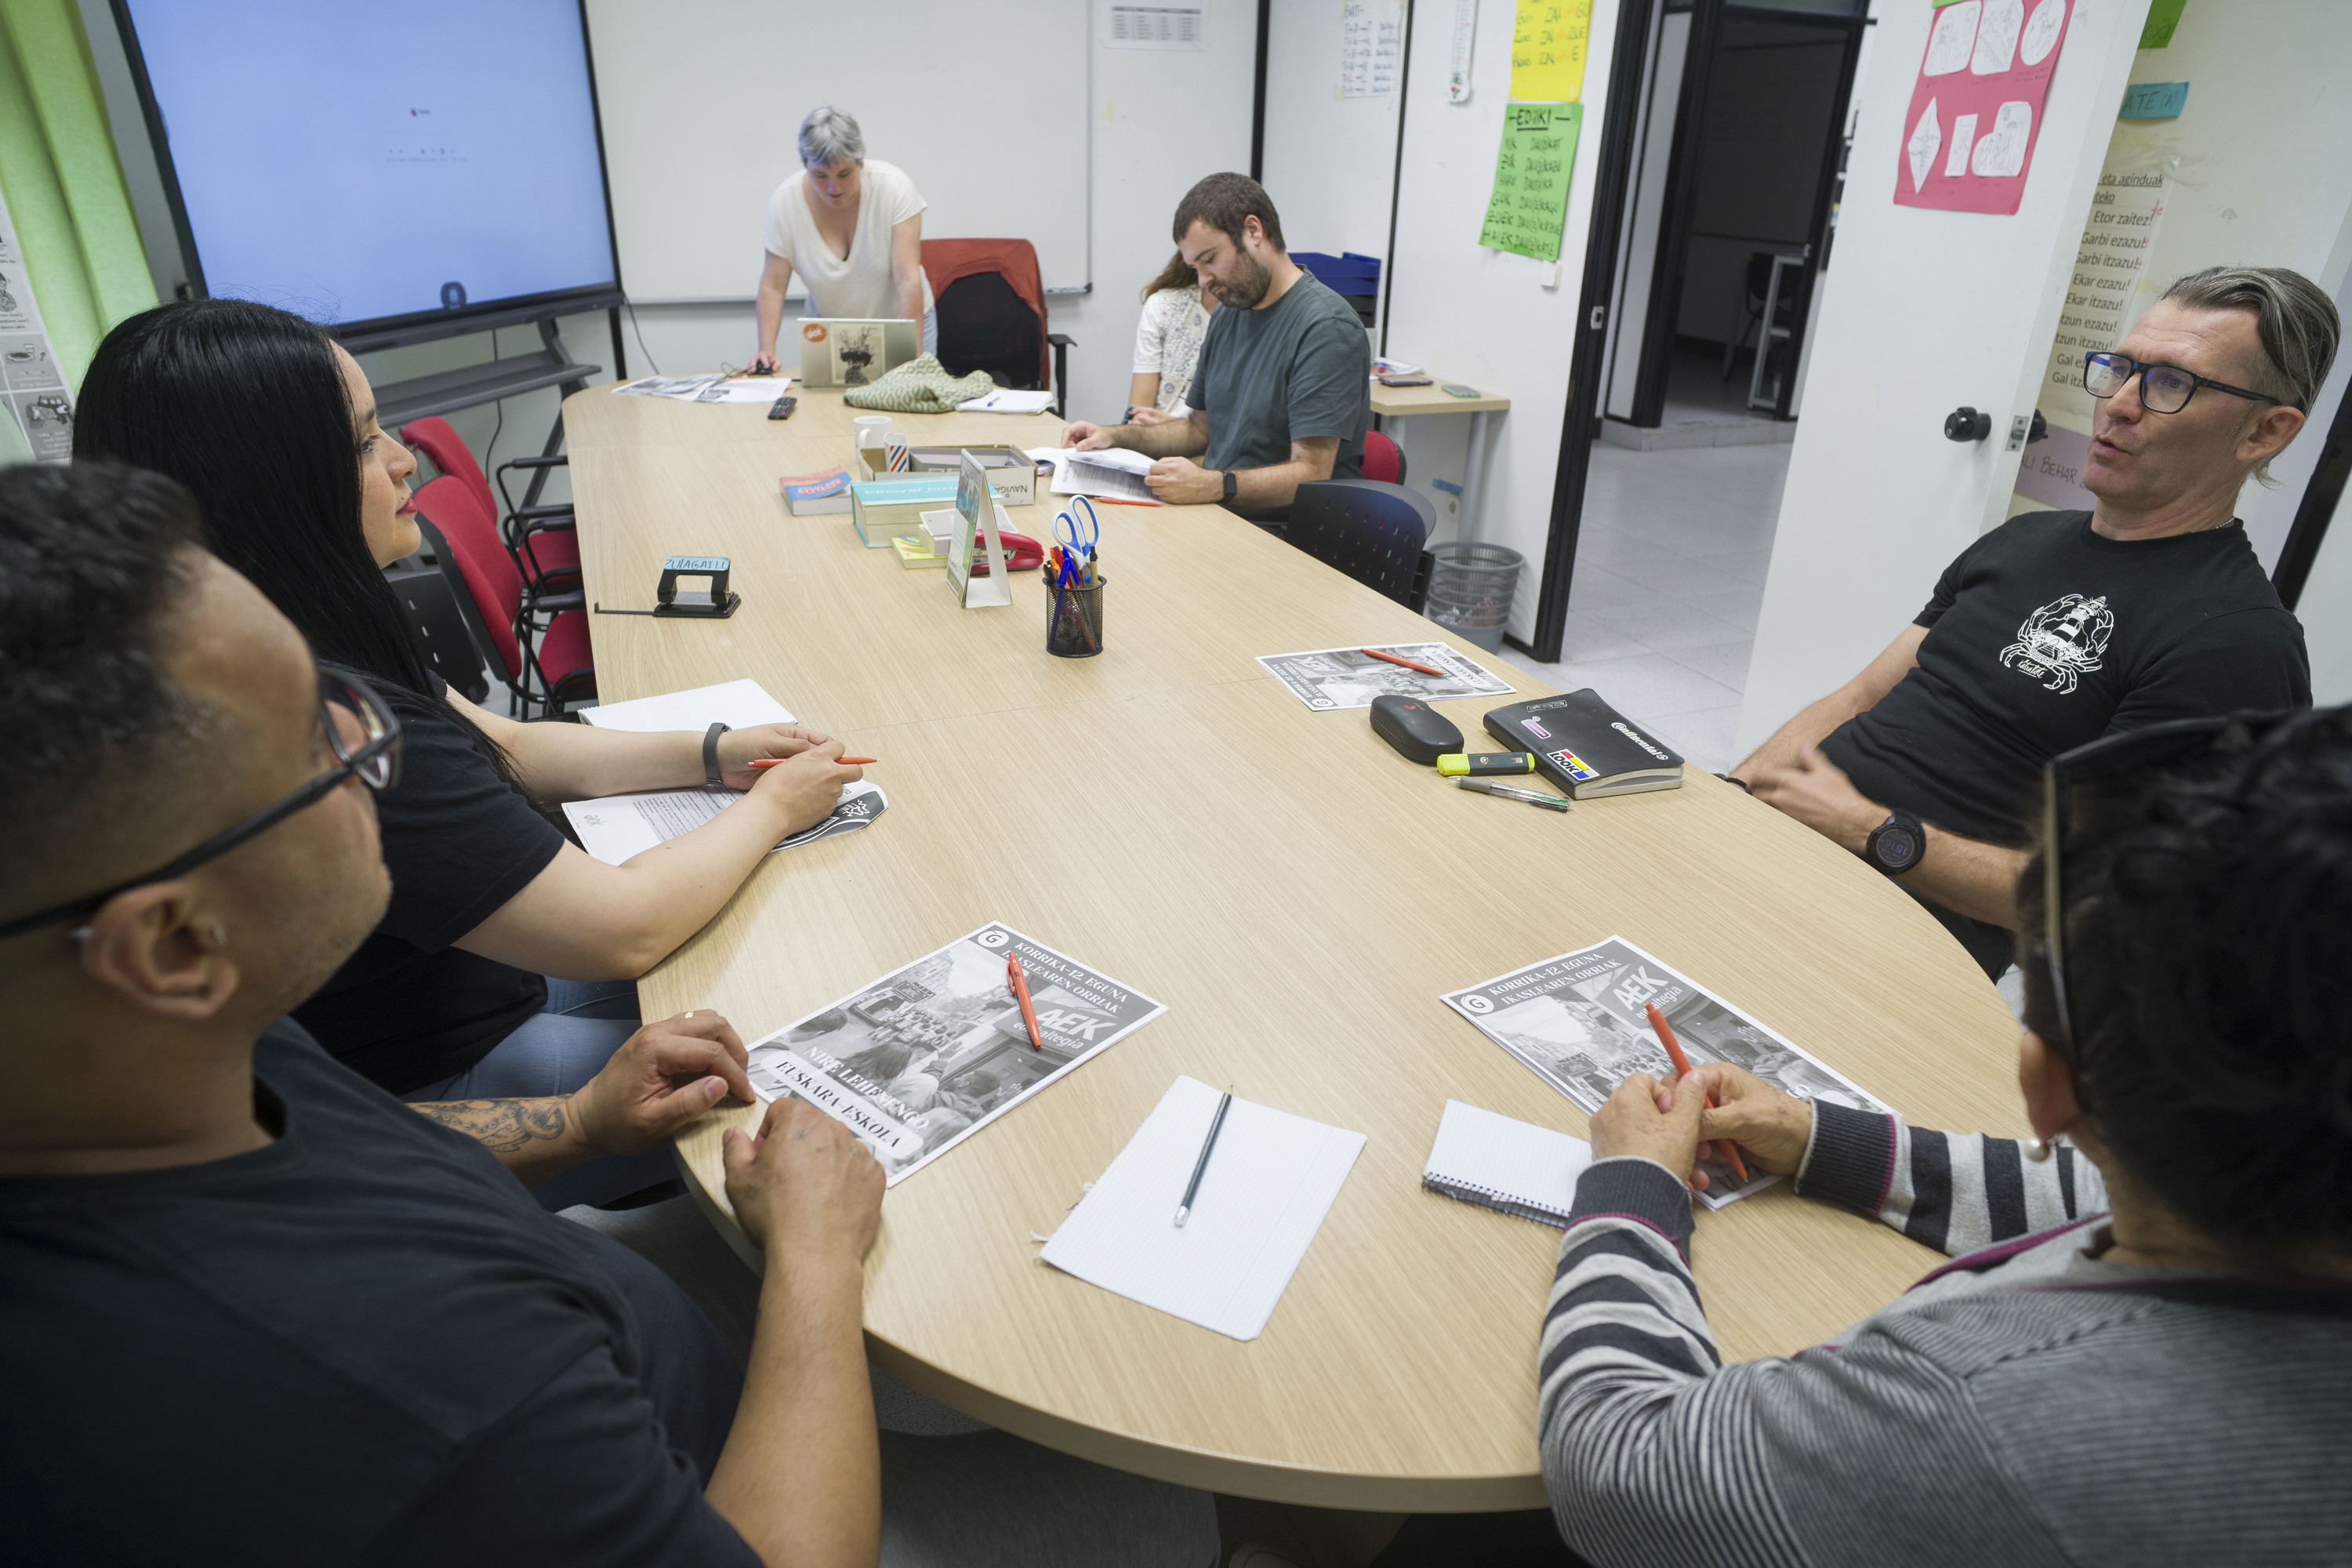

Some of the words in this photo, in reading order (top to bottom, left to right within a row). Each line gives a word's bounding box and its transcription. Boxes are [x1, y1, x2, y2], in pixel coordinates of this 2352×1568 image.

[2102, 174, 2116, 184] eta
[2118, 173, 2164, 186] aginduak
[2093, 211, 2116, 223] Etor
[2117, 212, 2154, 226] zaitez!
[2082, 232, 2109, 245] Garbi
[2073, 273, 2096, 287] Ekar
[2097, 278, 2131, 291] ezazu!
[2066, 292, 2088, 305] Ekar
[2089, 295, 2123, 311] itzazu!
[2084, 318, 2118, 332] ezazu!
[2078, 335, 2113, 351] itzazu!
[2057, 354, 2074, 366] Gal
[2053, 372, 2069, 384] Gal
[2040, 456, 2078, 485] BEHAR
[1292, 655, 1334, 674] AEK
[1611, 722, 1663, 757] Continental
[1550, 753, 1580, 773] LOOK
[985, 934, 1003, 944] G
[1001, 950, 1076, 989] IASLEAREN
[1073, 986, 1122, 1014] ORRIAK
[1014, 942, 1083, 982] KORRIKA-12.
[1085, 977, 1129, 1003] EGUNA
[1488, 966, 1564, 996] KORRIKA-12.
[1563, 953, 1606, 971] EGUNA
[1501, 975, 1576, 1005] IKASLEAREN
[1574, 959, 1622, 981] ORRIAK
[1613, 965, 1669, 1011] AEK
[1468, 998, 1485, 1009] G
[1635, 985, 1683, 1020] eualtegia
[1013, 1022, 1084, 1051] eualtegia
[1036, 1009, 1116, 1041] AEK
[804, 1047, 844, 1073] NIRE
[775, 1062, 902, 1148] EUSKARA-ESKOLA
[837, 1069, 930, 1131] LEHENENGO
